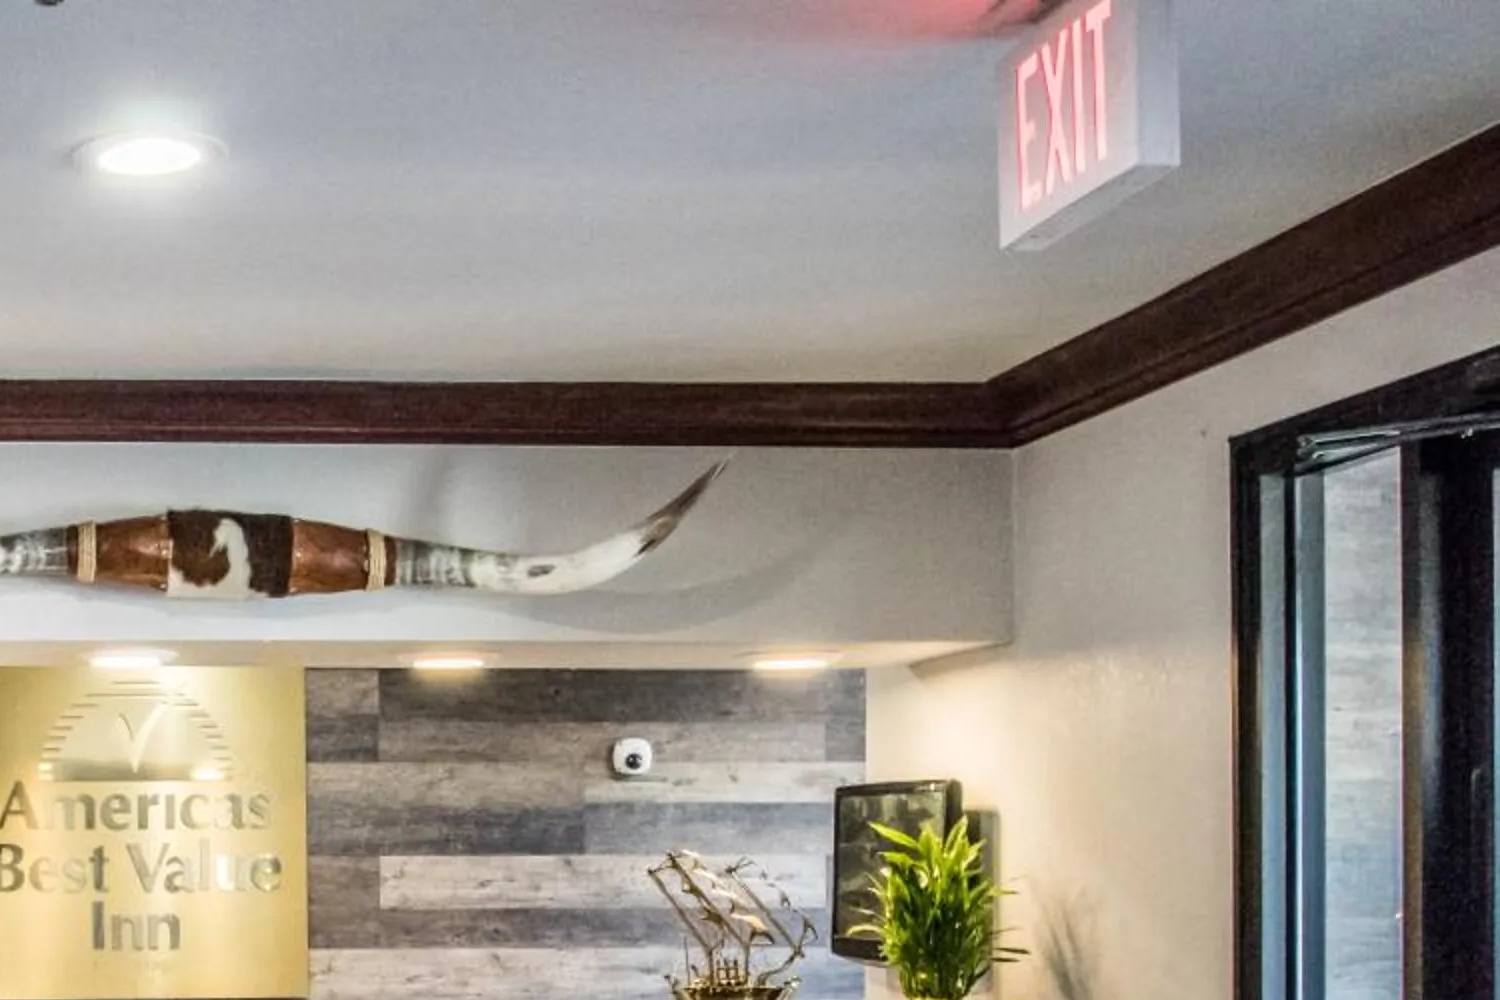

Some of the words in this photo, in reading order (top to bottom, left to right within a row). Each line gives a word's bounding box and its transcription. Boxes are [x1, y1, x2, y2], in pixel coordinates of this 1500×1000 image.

[1015, 0, 1111, 212] EXIT
[126, 838, 282, 893] Value
[91, 901, 181, 951] Inn
